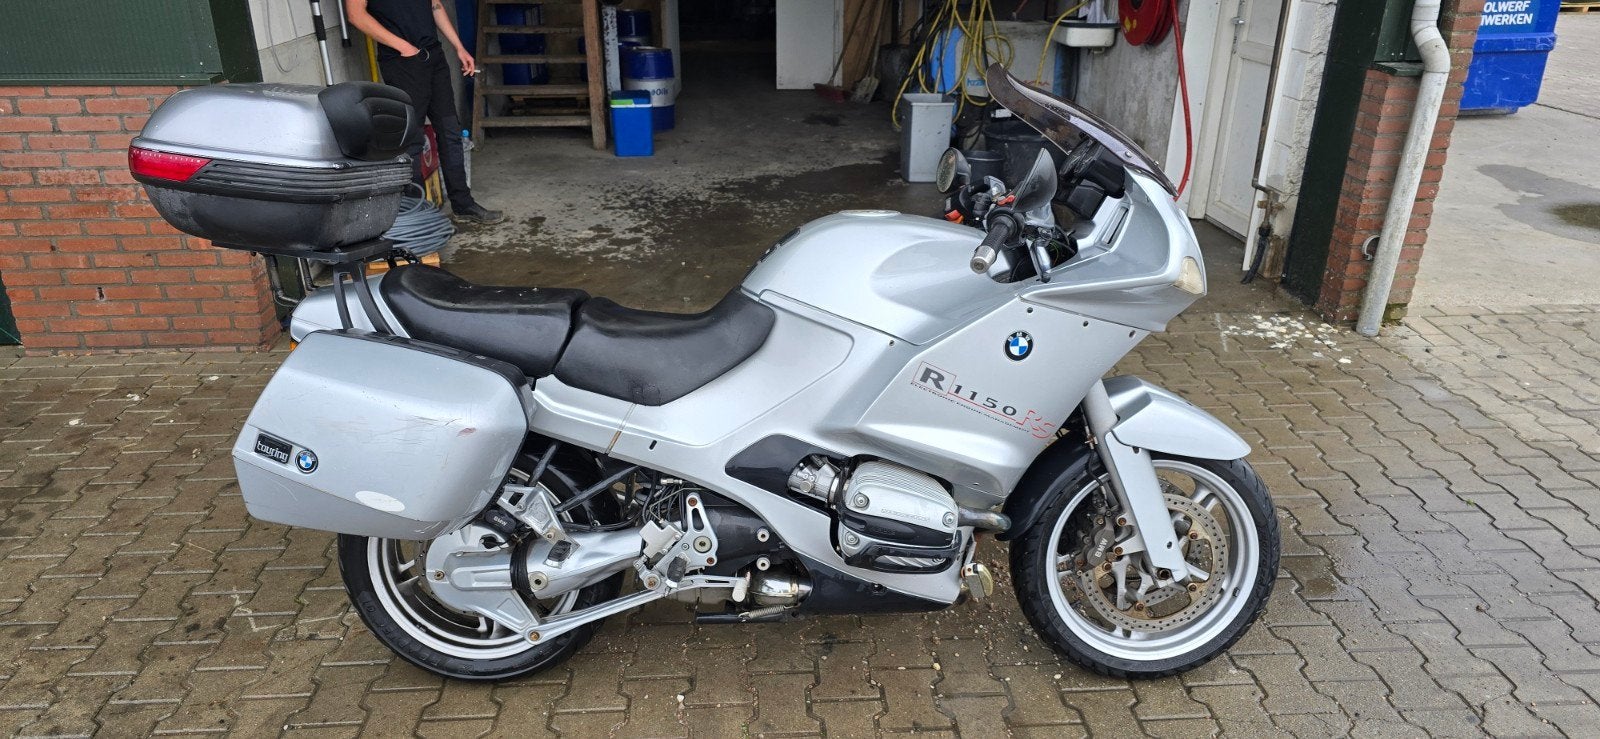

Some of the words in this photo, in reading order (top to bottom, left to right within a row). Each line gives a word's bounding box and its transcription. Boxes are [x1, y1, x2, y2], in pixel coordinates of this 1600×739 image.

[1483, 1, 1531, 13] OLWERF
[919, 366, 945, 391] R
[953, 384, 1018, 417] 1150
[256, 440, 288, 462] touring
[493, 515, 508, 527] BMW
[1094, 537, 1108, 558] BMW
